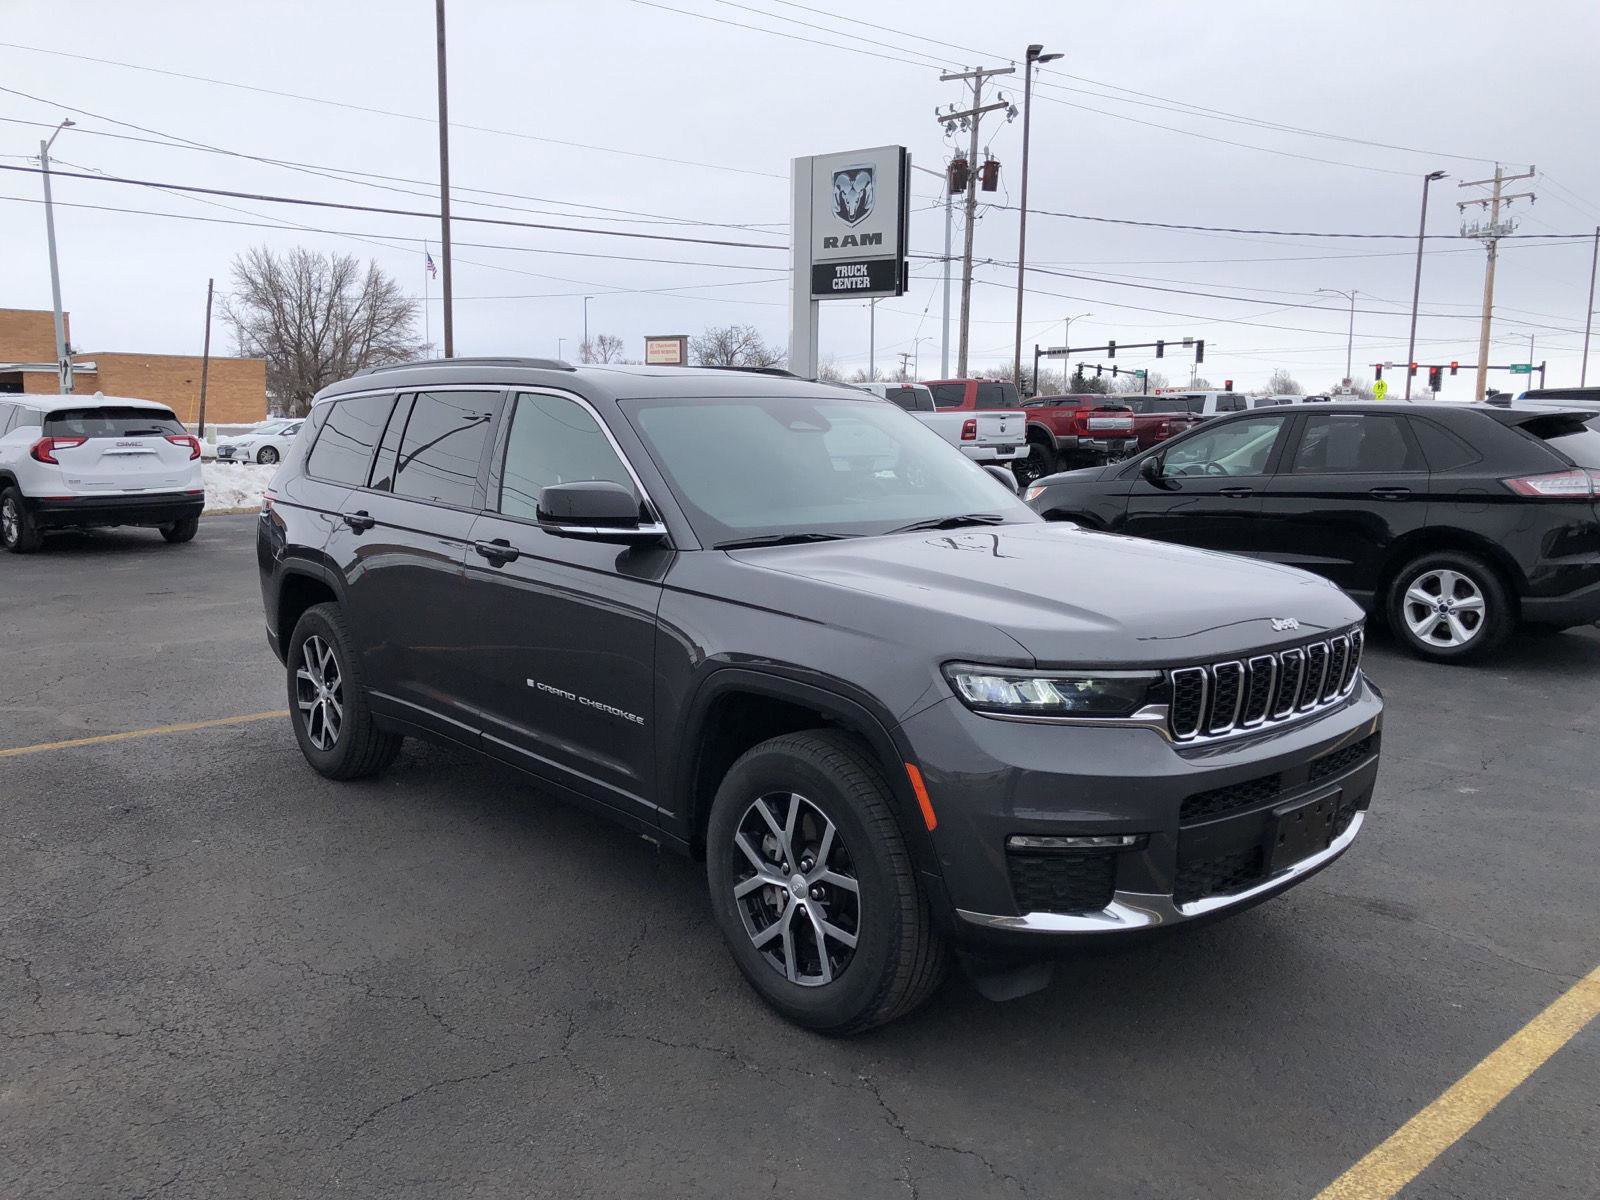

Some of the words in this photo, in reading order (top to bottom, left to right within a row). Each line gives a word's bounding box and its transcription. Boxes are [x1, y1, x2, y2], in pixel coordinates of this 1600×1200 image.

[823, 232, 883, 249] RAM
[835, 264, 868, 277] TRUCK
[832, 276, 871, 290] CENTER
[1270, 617, 1300, 632] Jeep
[536, 682, 576, 701] GRAND
[578, 696, 645, 726] CHEROKEE
